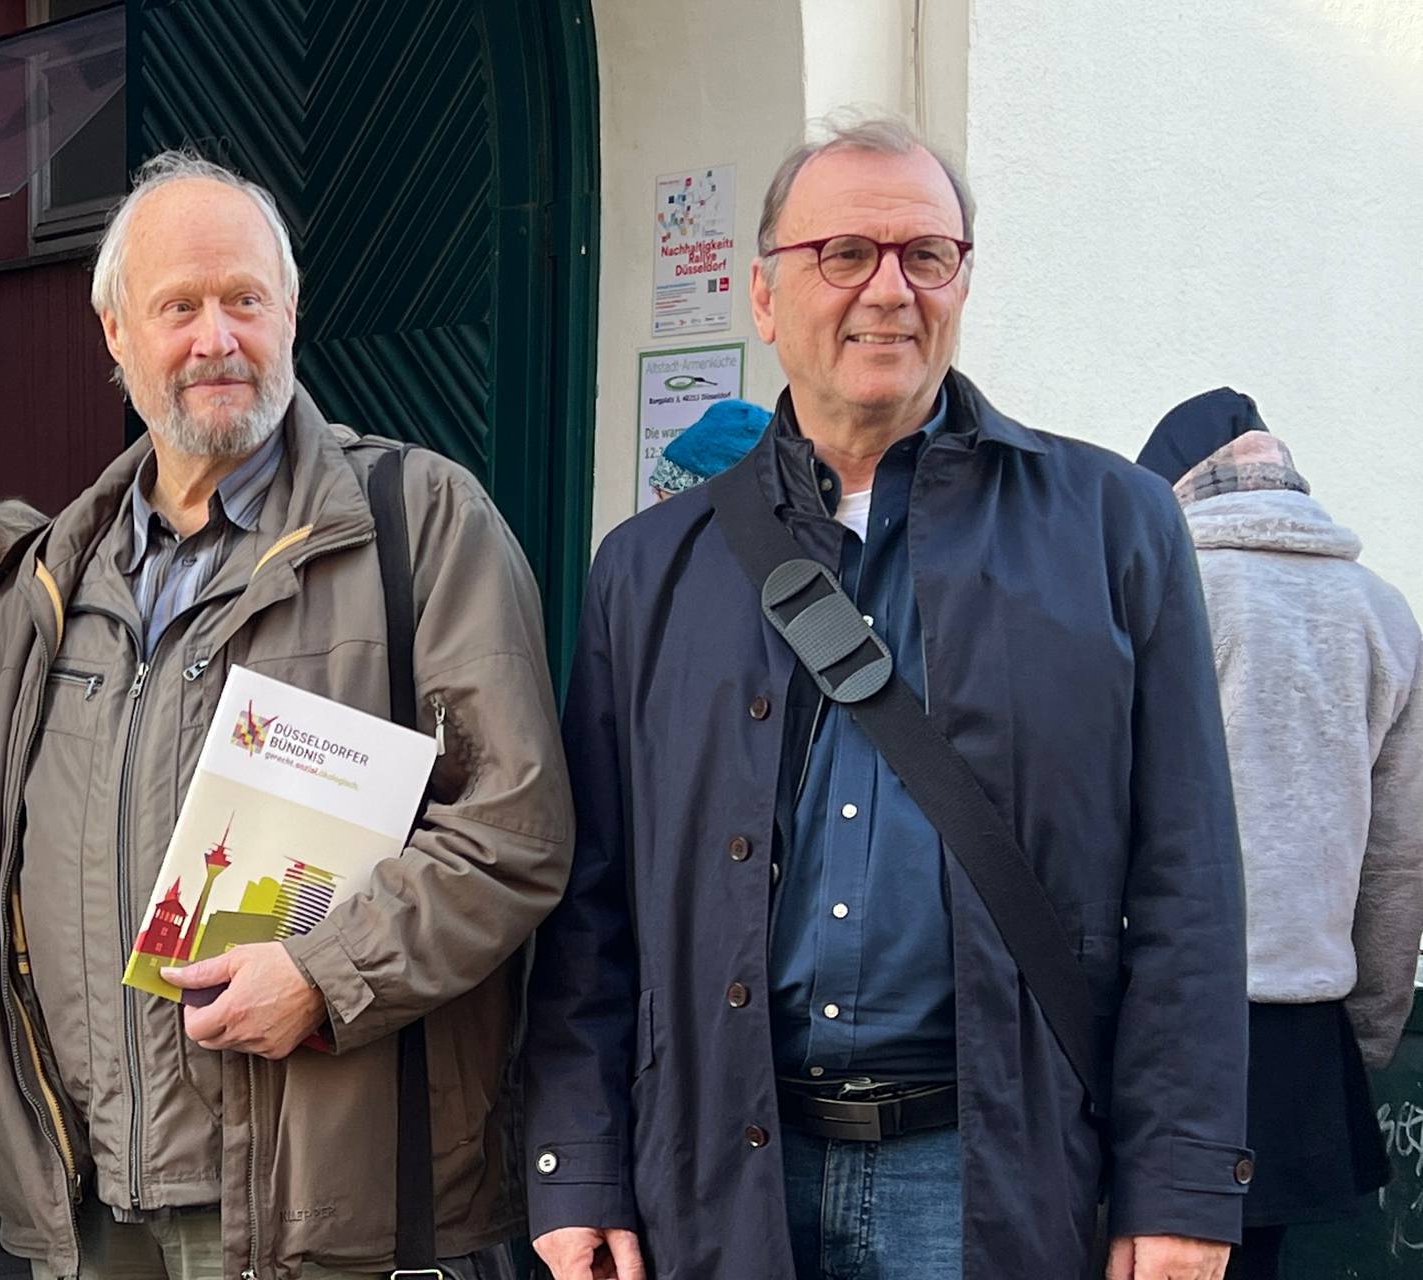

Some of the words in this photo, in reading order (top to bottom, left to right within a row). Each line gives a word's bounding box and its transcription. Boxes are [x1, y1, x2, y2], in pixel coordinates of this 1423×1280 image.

[661, 237, 734, 257] Nachhaltigkeits
[675, 258, 727, 277] Düsseldorf
[688, 251, 717, 265] Rallye
[644, 427, 660, 440] Die
[661, 427, 686, 439] war
[269, 736, 326, 765] BÜNDNIS
[274, 722, 370, 767] DÜSSELDORFER
